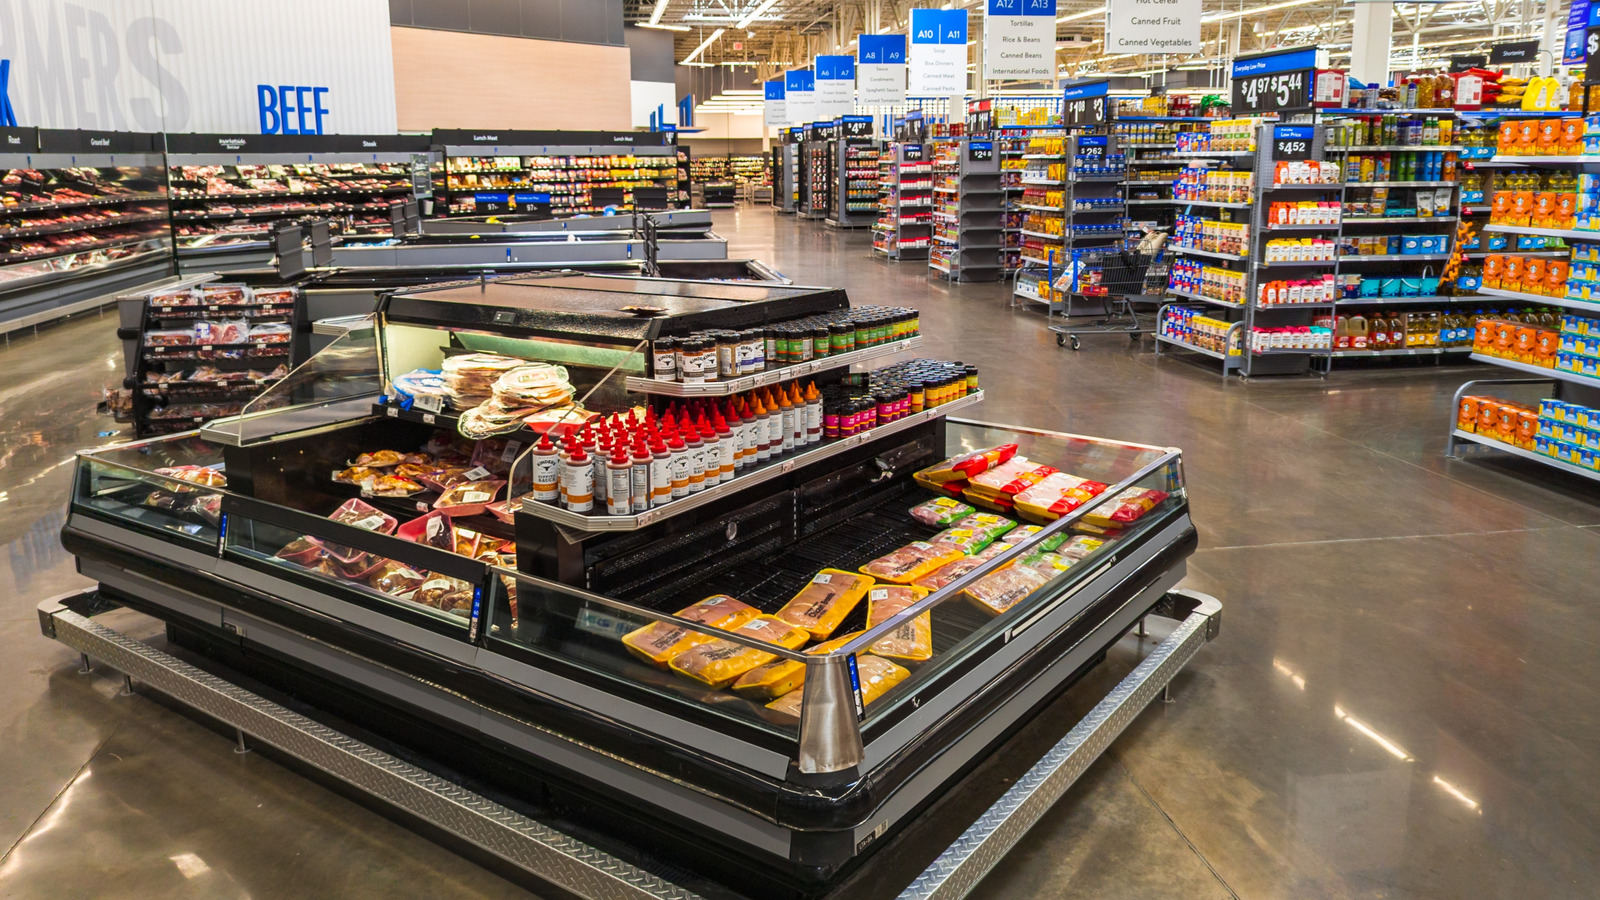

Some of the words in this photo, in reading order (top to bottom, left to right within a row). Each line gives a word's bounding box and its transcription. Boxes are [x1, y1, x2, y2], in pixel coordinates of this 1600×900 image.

[996, 0, 1014, 8] A12
[1031, 0, 1048, 8] A13
[1131, 16, 1161, 25] Canned
[1163, 17, 1181, 25] Fruit
[917, 30, 934, 39] A10
[947, 30, 960, 39] A11
[1118, 38, 1148, 46] Canned
[1150, 38, 1192, 48] Vegetables
[1235, 64, 1250, 72] Everyday
[258, 84, 330, 135] BEEF
[7, 134, 21, 145] Roast
[90, 138, 103, 146] Ground
[102, 138, 110, 146] Beef
[362, 140, 377, 148] Steak
